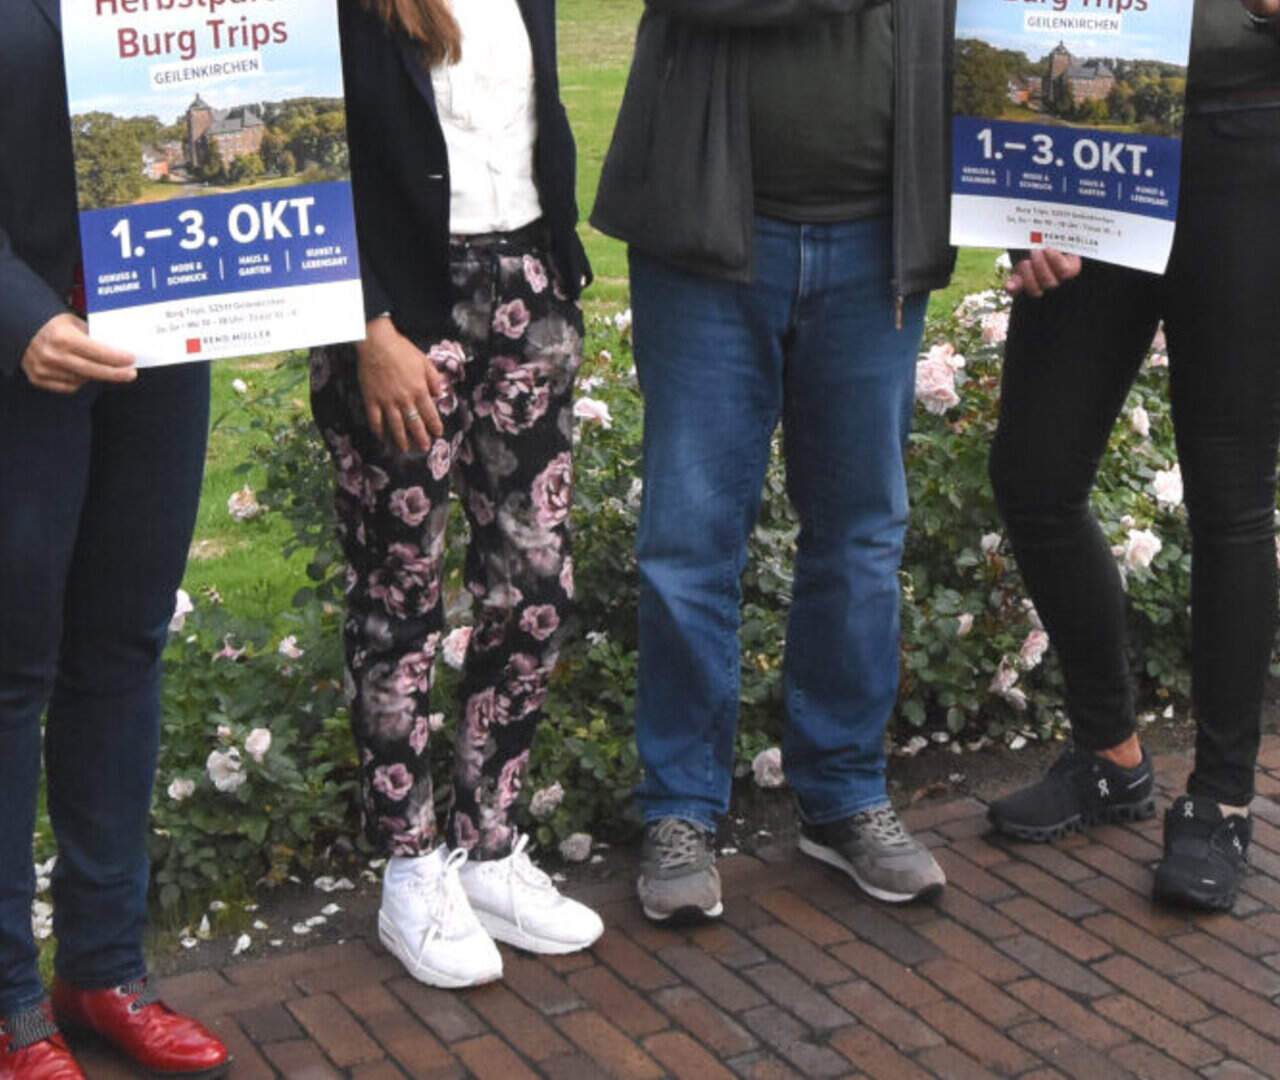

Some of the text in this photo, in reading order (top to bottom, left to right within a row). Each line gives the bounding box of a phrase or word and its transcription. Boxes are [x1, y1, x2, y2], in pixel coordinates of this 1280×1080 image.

[117, 17, 288, 60] Burg Trips
[1027, 16, 1120, 31] GEILENKIRCHEN
[154, 58, 260, 86] GEILENKIRCHEN
[1073, 139, 1154, 178] OKT.
[228, 197, 326, 244] OKT.
